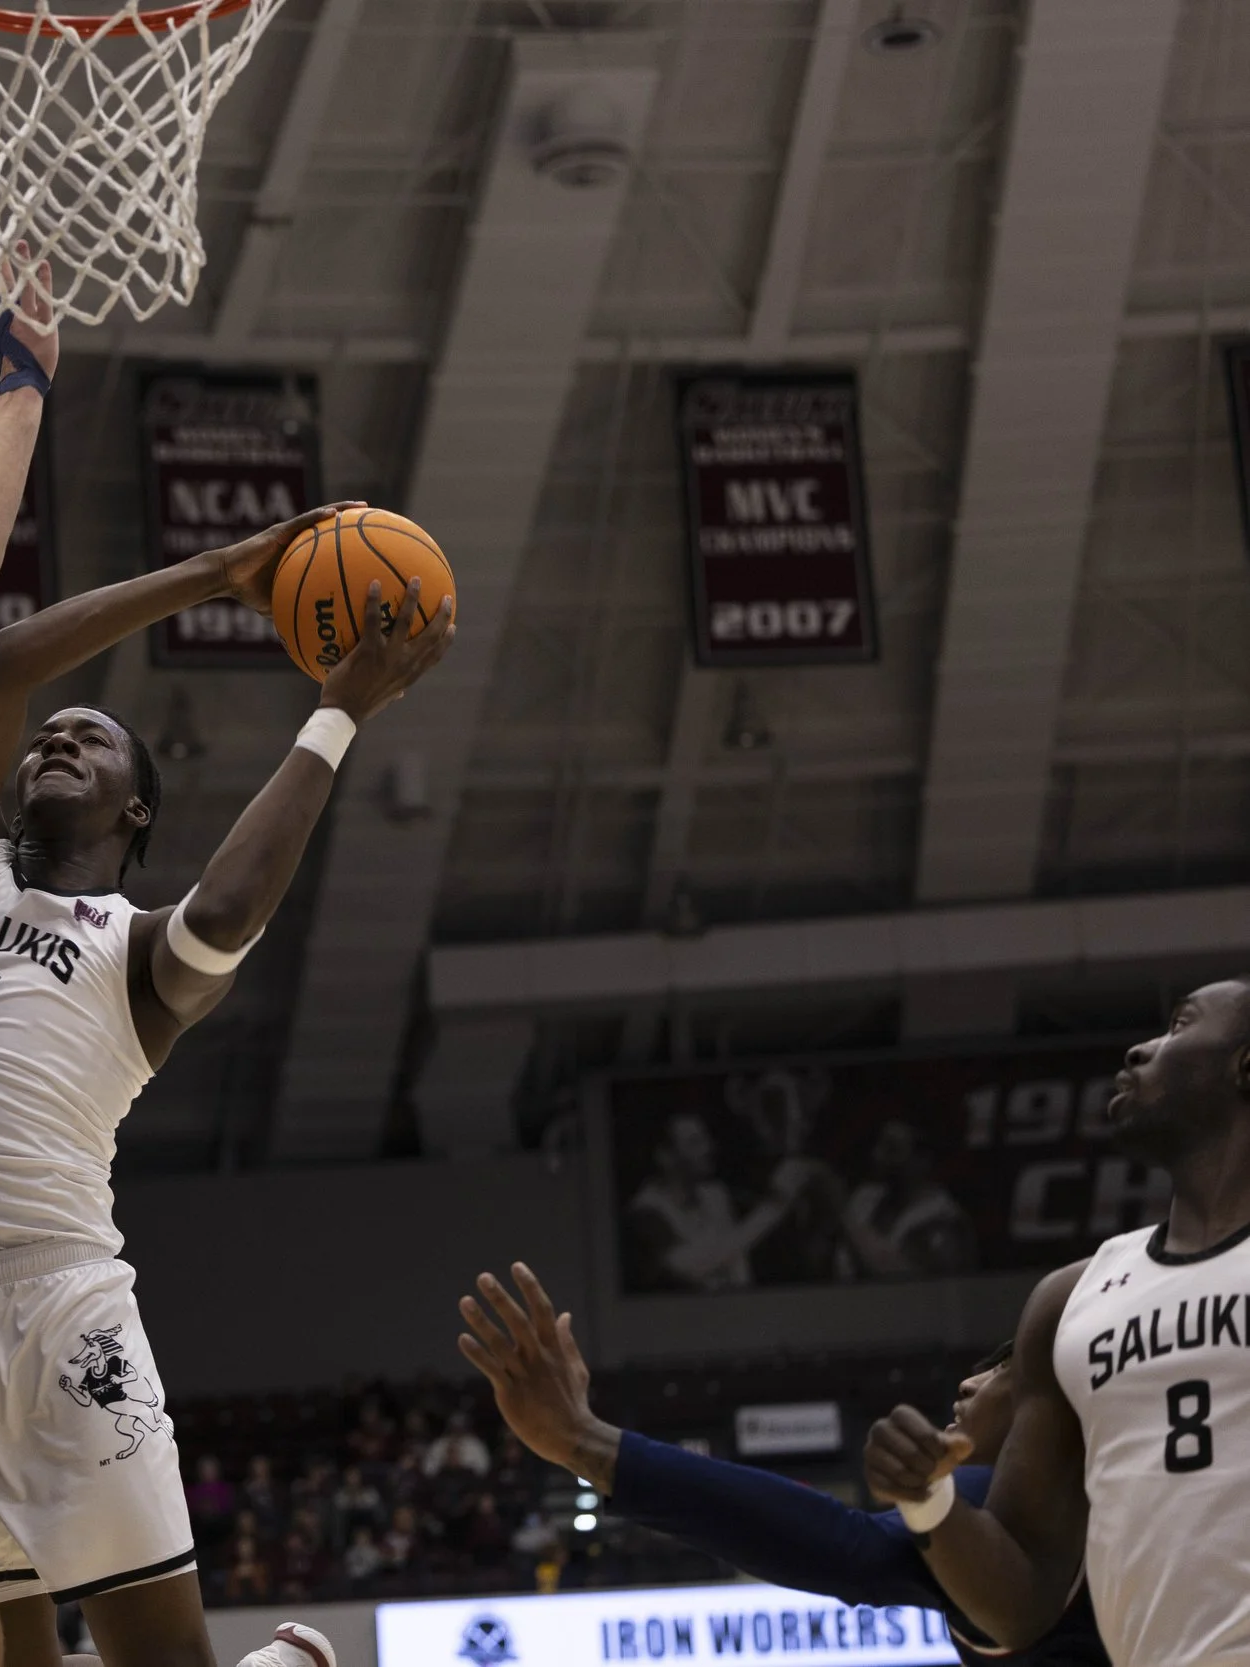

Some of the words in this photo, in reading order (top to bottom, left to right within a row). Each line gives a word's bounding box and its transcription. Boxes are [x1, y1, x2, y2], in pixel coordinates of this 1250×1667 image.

[168, 478, 296, 524] NCAA
[724, 478, 824, 523] MVC
[700, 525, 856, 556] CHAMPIONS
[710, 600, 856, 641] 2007
[1165, 1379, 1213, 1474] 8
[602, 1618, 693, 1659] IRON
[709, 1606, 906, 1654] WORKERS
